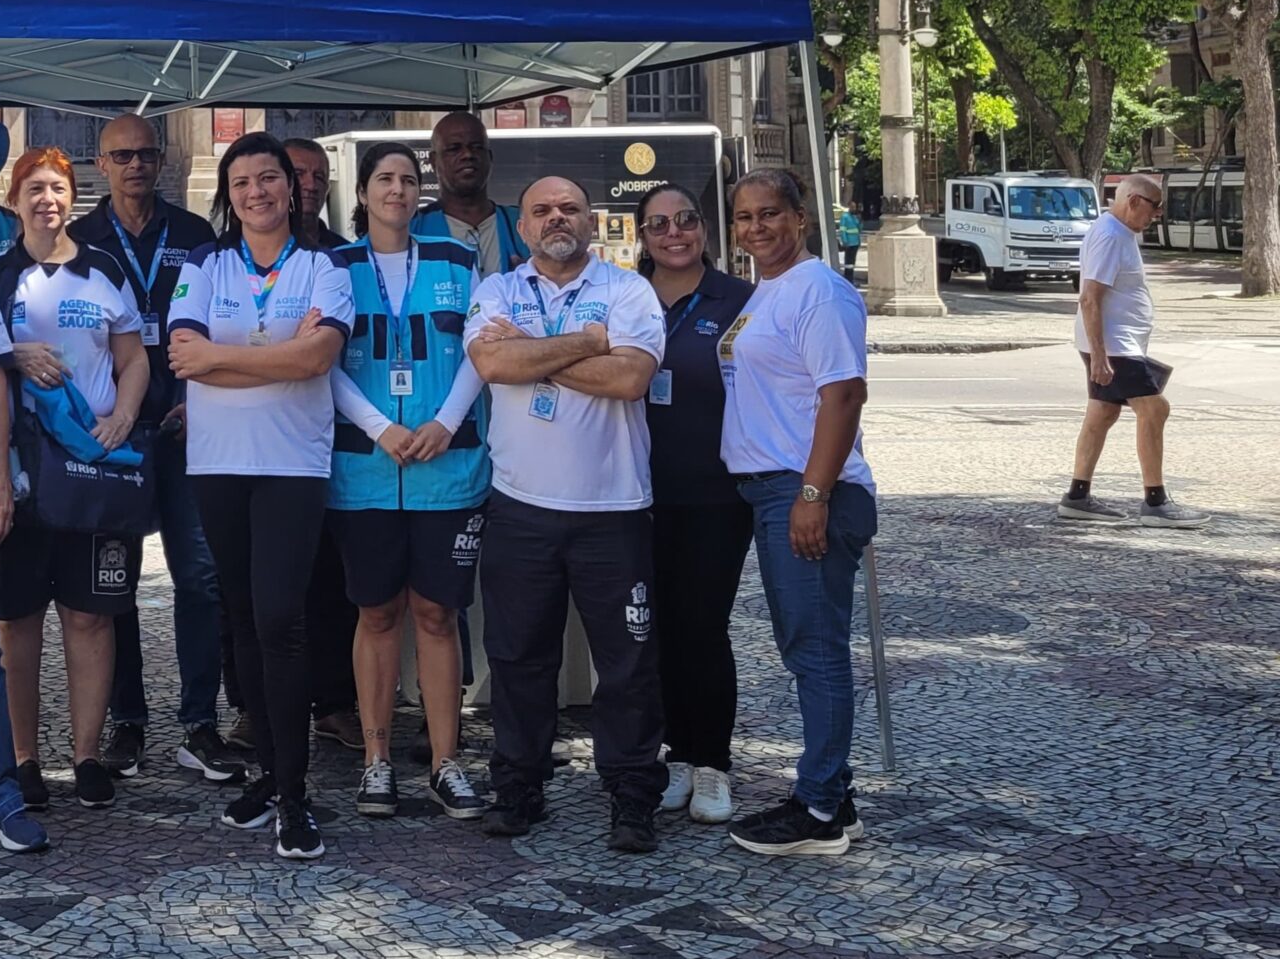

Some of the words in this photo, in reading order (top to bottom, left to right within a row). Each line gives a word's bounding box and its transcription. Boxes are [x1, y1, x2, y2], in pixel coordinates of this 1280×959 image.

[58, 299, 102, 311] AGENTE
[222, 298, 240, 308] Rio
[522, 303, 539, 312] Rio
[576, 301, 608, 311] AGENTE
[78, 463, 97, 475] Rio
[98, 570, 127, 583] RIO
[625, 605, 650, 623] Rio
